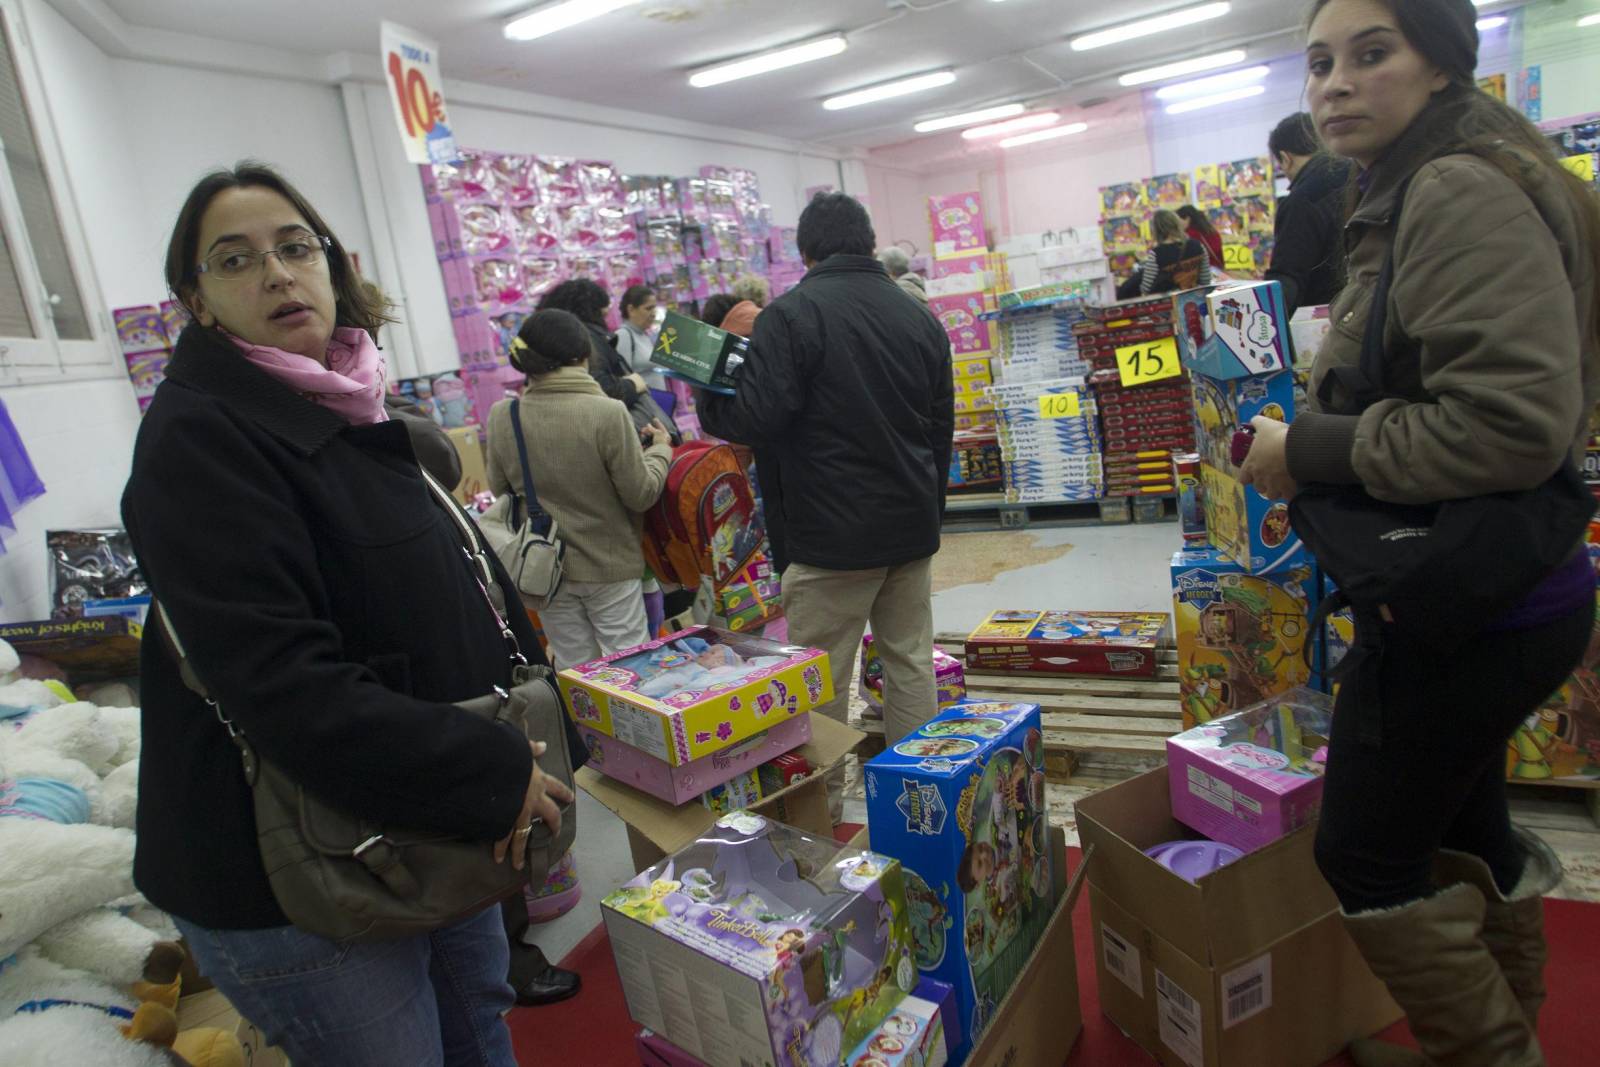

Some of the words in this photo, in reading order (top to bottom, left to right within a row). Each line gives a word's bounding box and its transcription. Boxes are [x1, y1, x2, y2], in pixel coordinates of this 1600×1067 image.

[1127, 344, 1164, 376] 15
[1043, 396, 1069, 415] 10
[1176, 575, 1217, 592] Disney
[55, 619, 105, 633] Knights
[909, 791, 920, 824] HEROES
[919, 784, 938, 835] Disney
